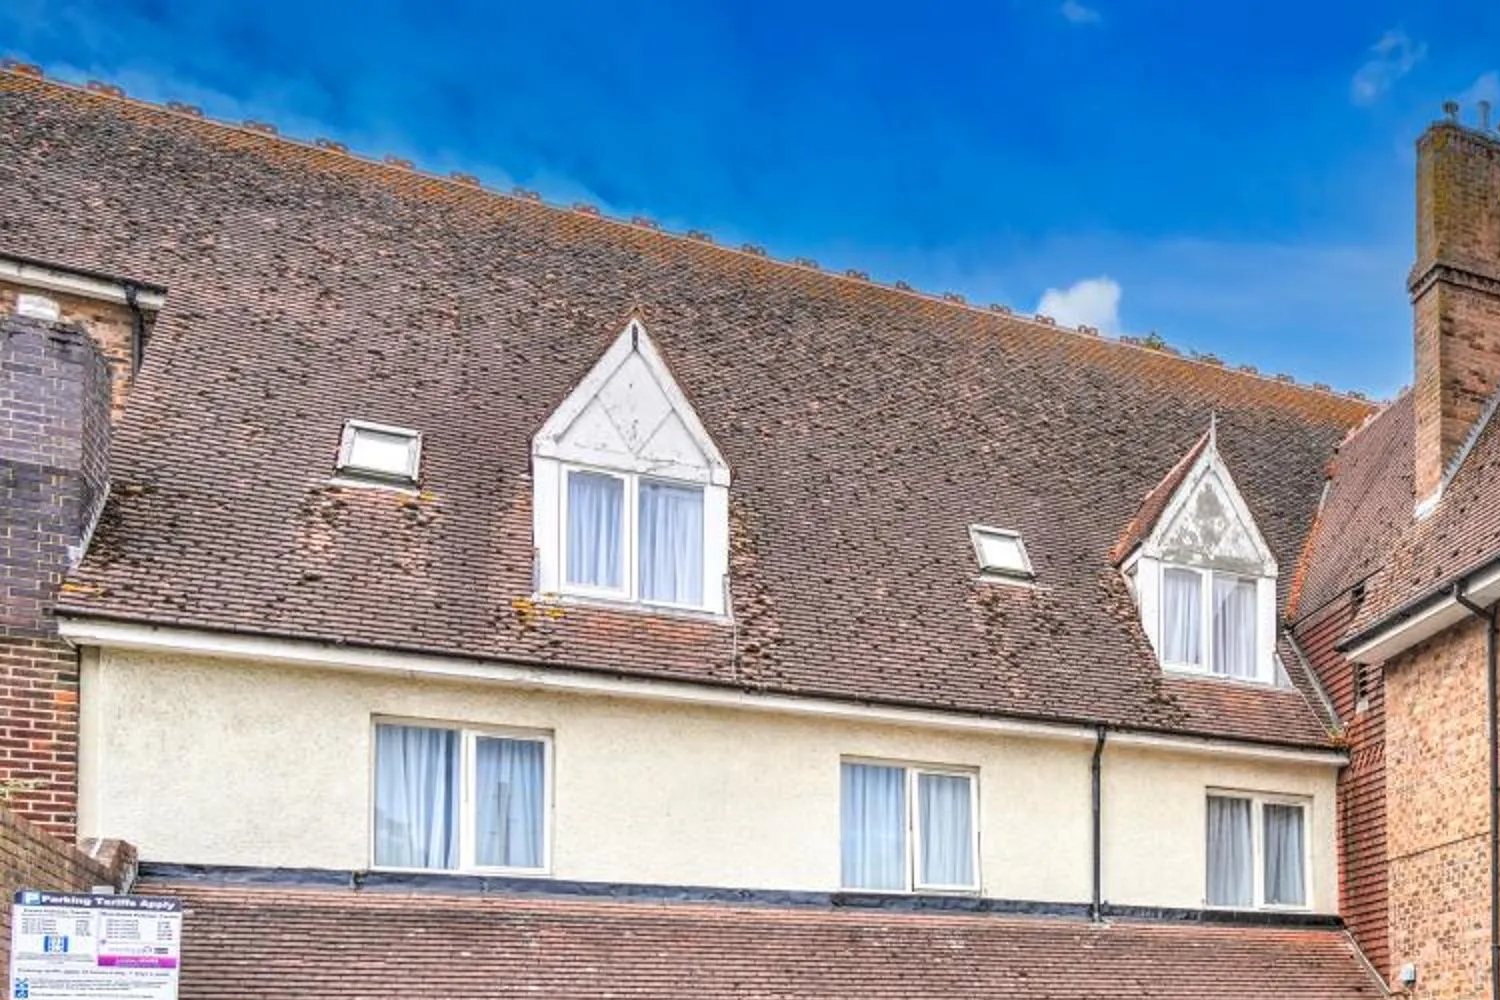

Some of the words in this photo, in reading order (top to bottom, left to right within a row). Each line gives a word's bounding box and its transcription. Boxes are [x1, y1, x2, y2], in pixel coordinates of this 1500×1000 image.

[41, 895, 92, 906] Parking
[95, 897, 137, 907] Tariffs
[140, 899, 176, 911] Apply
